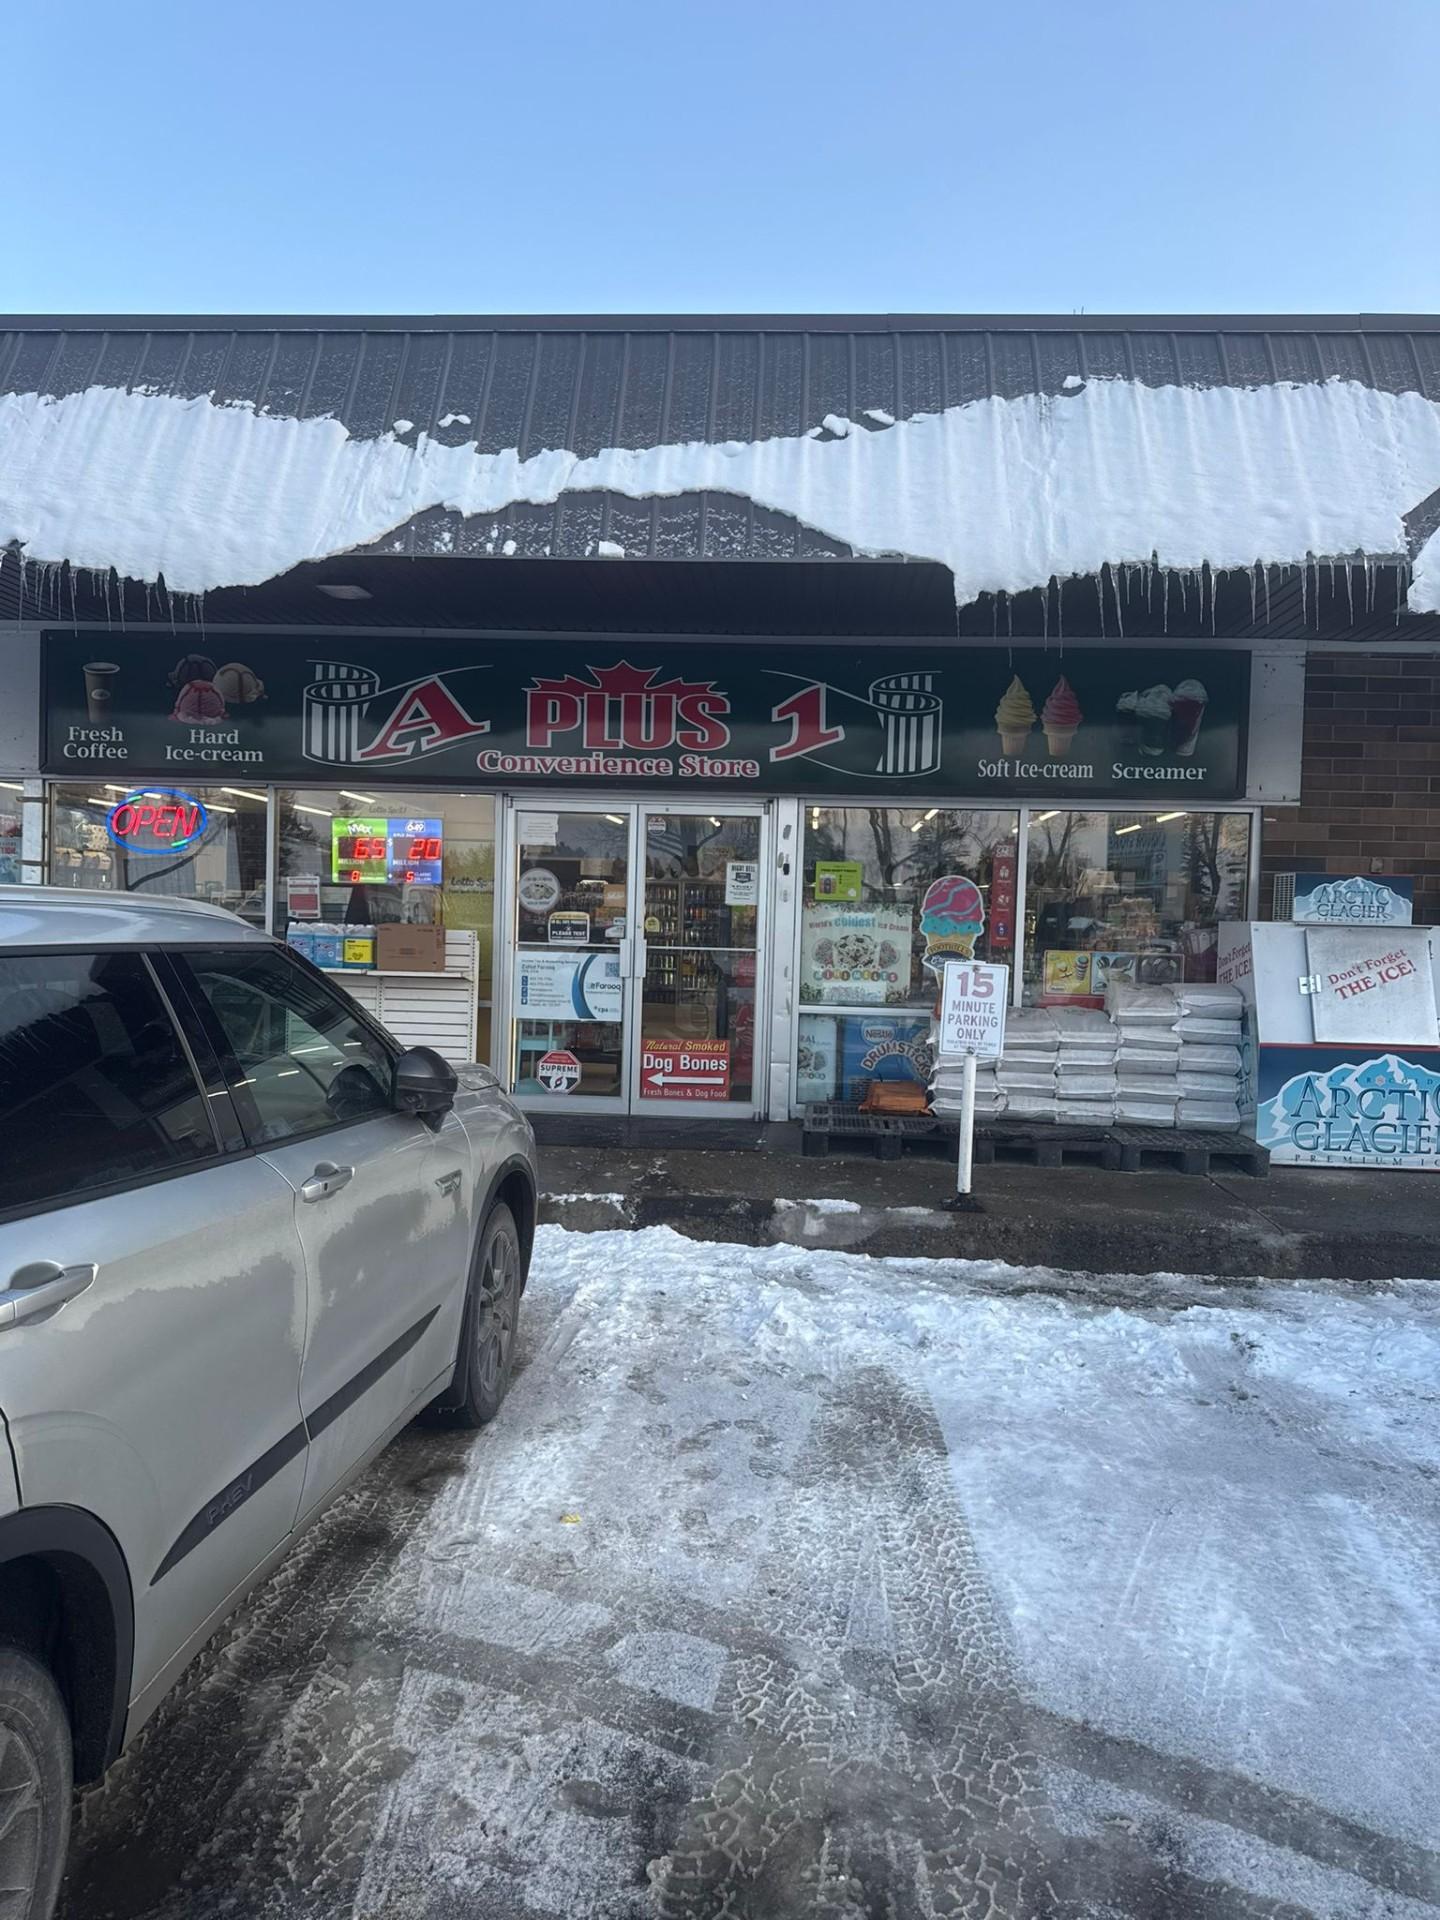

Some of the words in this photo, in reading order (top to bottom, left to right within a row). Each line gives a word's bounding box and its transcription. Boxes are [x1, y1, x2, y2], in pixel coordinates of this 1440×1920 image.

[358, 676, 491, 760] A
[525, 690, 731, 750] PLUS
[769, 683, 845, 763] 1
[68, 726, 124, 742] Fresh
[189, 729, 240, 745] Hard
[63, 743, 128, 760] Coffee
[165, 745, 264, 763] Ice-cream
[476, 750, 674, 777] Convenience
[678, 753, 760, 777] Store
[977, 758, 1011, 779] Soft
[1014, 759, 1094, 779] Ice-cream
[1111, 762, 1207, 781] Screamer
[111, 804, 199, 838] OPEN
[354, 838, 386, 858] 65
[408, 839, 442, 860] 20
[1317, 885, 1391, 906] ARCTIC
[1316, 903, 1392, 919] GLACIER
[1327, 965, 1364, 985] Don't
[1363, 949, 1407, 971] Forget
[956, 971, 994, 998] 15
[1334, 975, 1377, 1001] THE
[1378, 958, 1418, 984] ICE!
[952, 1000, 996, 1014] MINUTE
[947, 1013, 999, 1028] PARKING
[956, 1027, 986, 1040] ONLY
[645, 1040, 682, 1051] Natural
[684, 1041, 726, 1052] Smoked
[540, 1064, 578, 1072] SUPREME
[643, 1053, 673, 1072] Dog
[680, 1054, 728, 1071] Bones
[643, 1088, 662, 1096] Fresh
[664, 1088, 684, 1097] Bones
[686, 1088, 693, 1096] &
[695, 1088, 709, 1098] Dog
[710, 1089, 727, 1098] Food
[1290, 1074, 1440, 1122] ARCTI
[1291, 1120, 1440, 1155] GLACIE
[1294, 1154, 1403, 1166] PREMIUM
